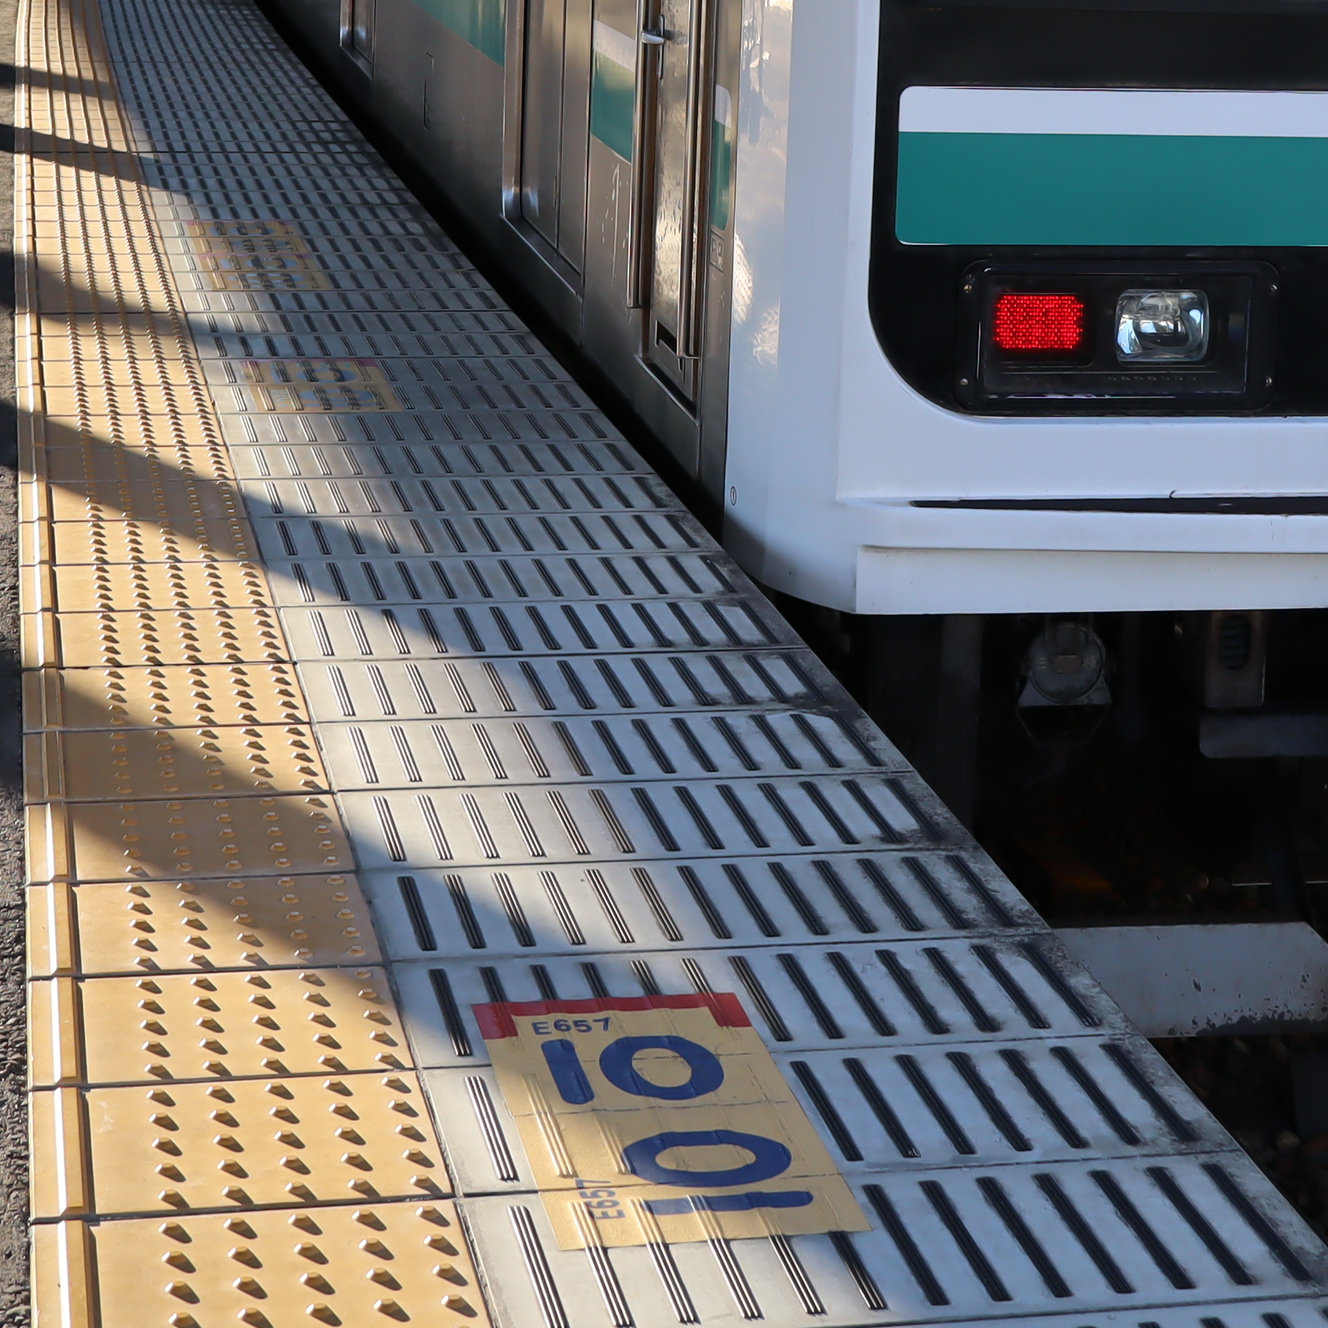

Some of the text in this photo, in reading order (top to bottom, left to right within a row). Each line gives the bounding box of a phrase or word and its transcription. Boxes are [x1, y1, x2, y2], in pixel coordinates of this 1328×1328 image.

[531, 1016, 612, 1036] E657
[540, 1035, 725, 1105] 10
[574, 1178, 626, 1221] E657
